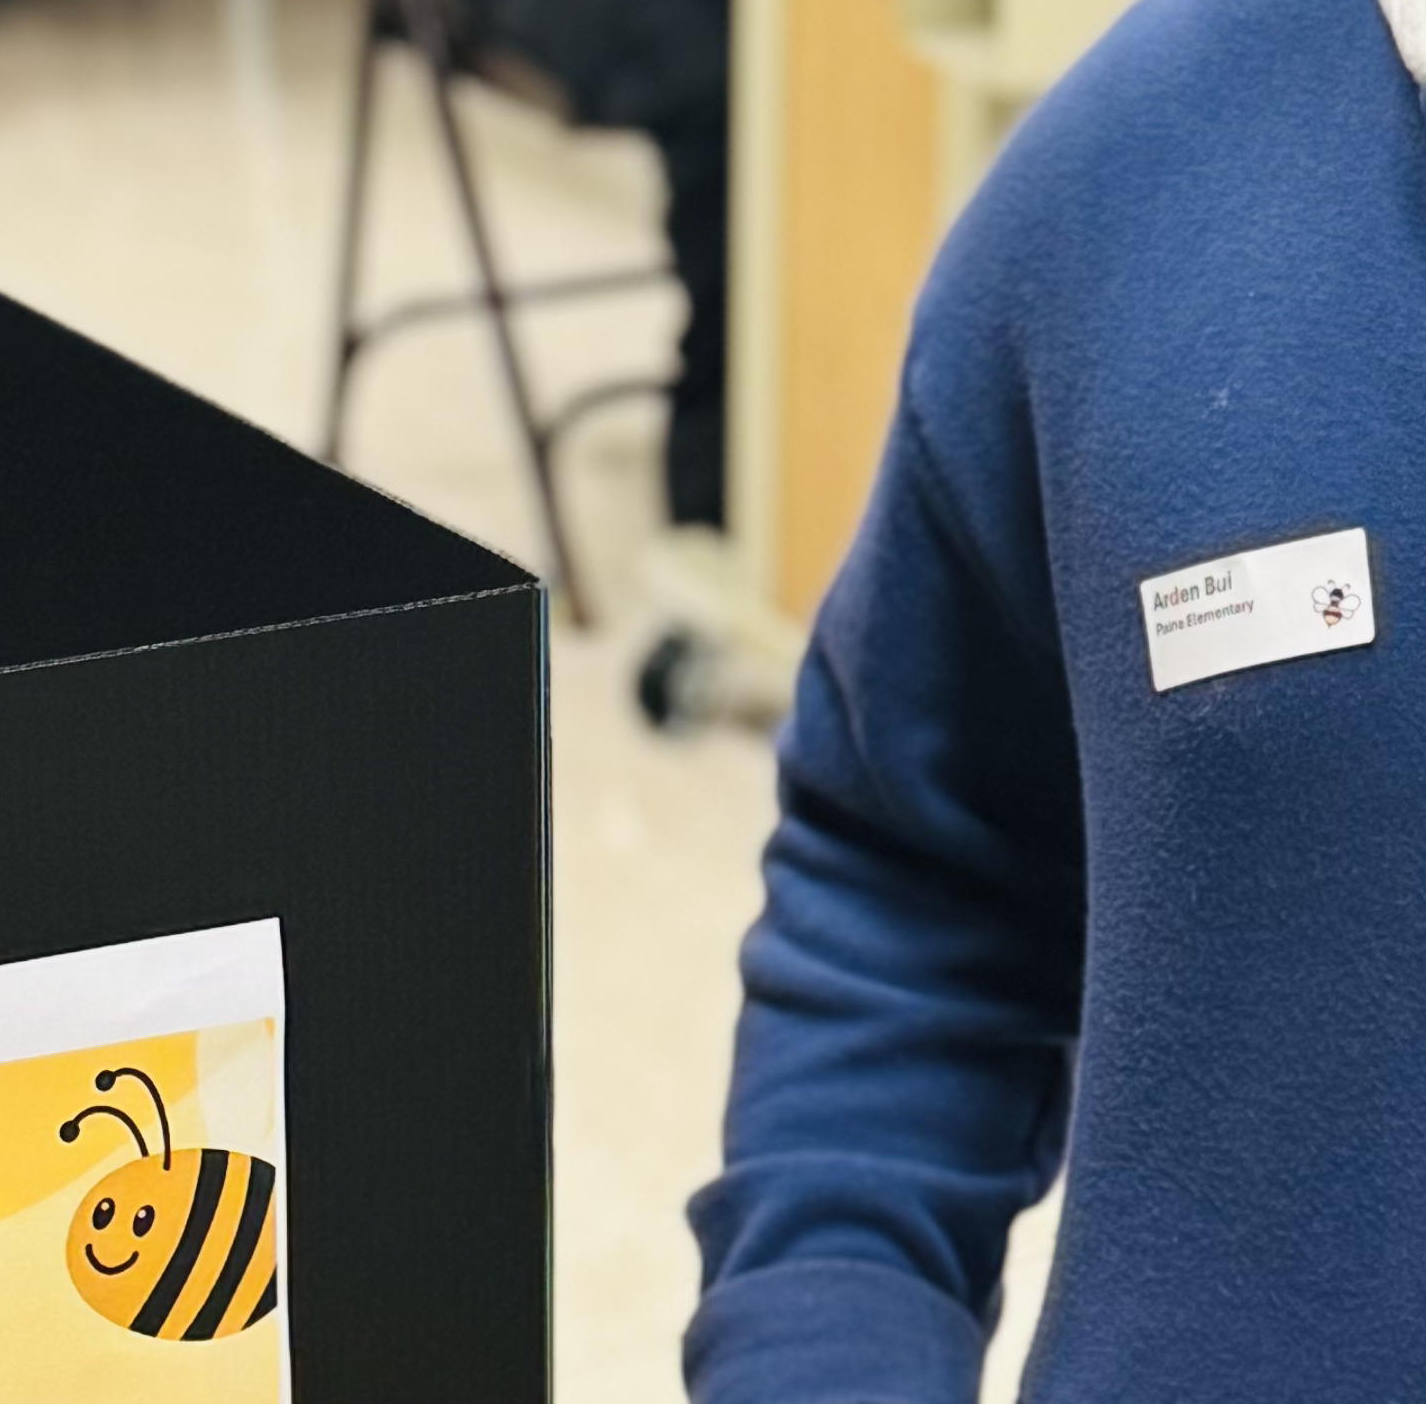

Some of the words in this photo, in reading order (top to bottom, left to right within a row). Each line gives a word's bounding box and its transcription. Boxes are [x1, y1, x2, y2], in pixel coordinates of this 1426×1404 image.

[1153, 585, 1200, 611] Arden
[1204, 570, 1233, 596] Bui
[1156, 619, 1185, 636] Paine
[1186, 599, 1255, 628] Elementary
